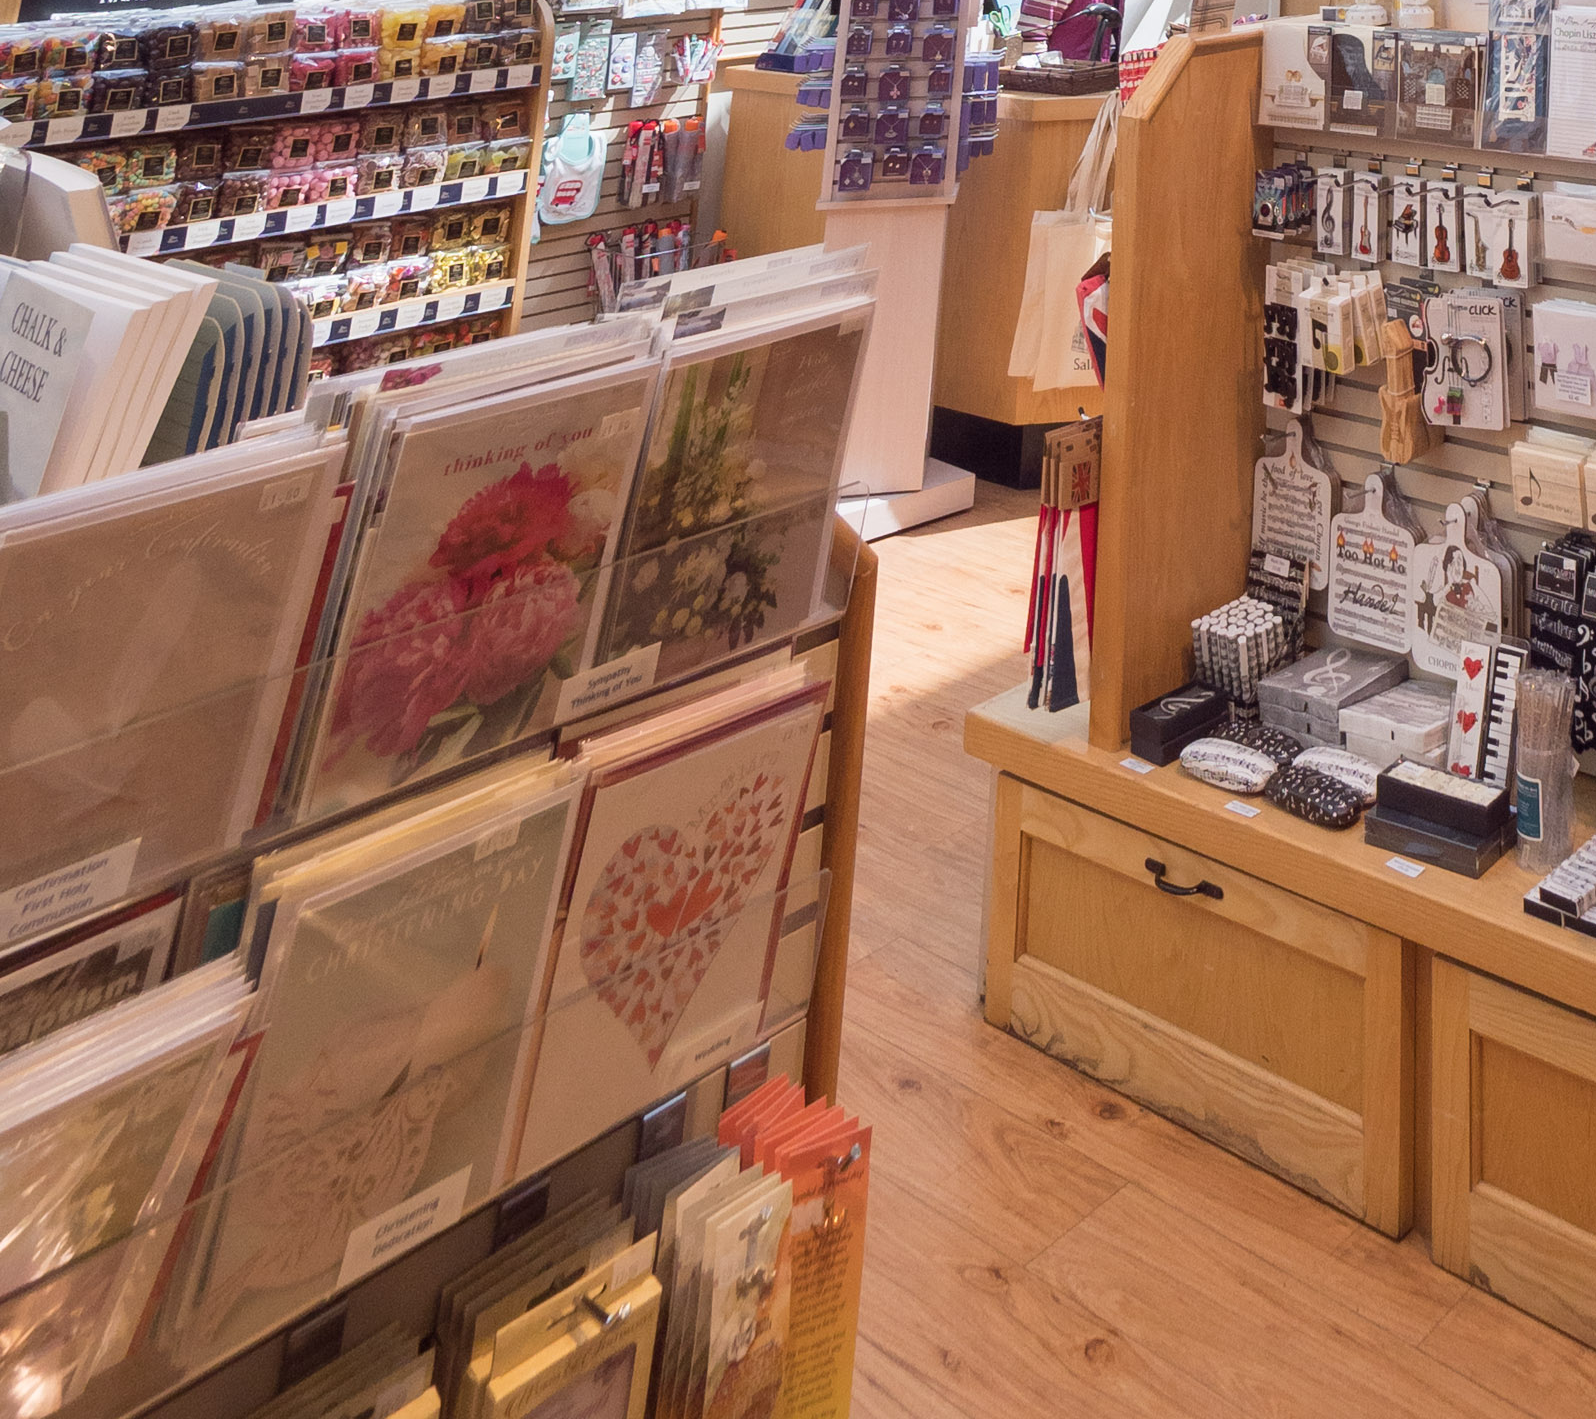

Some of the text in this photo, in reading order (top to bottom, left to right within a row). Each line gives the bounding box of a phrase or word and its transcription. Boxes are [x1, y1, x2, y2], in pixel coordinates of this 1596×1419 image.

[1554, 27, 1581, 39] Chopin
[1469, 305, 1496, 316] CLICK
[11, 302, 67, 357] CHALK &
[0, 350, 49, 403] CHEESE
[444, 427, 593, 476] thinking of you
[1336, 546, 1408, 576] Too Hot To
[1338, 581, 1402, 616] Handel
[587, 665, 633, 691] Sympathy
[1428, 655, 1460, 673] CHOPIN
[570, 687, 611, 709] Thinking
[14, 858, 109, 903] Confirmation
